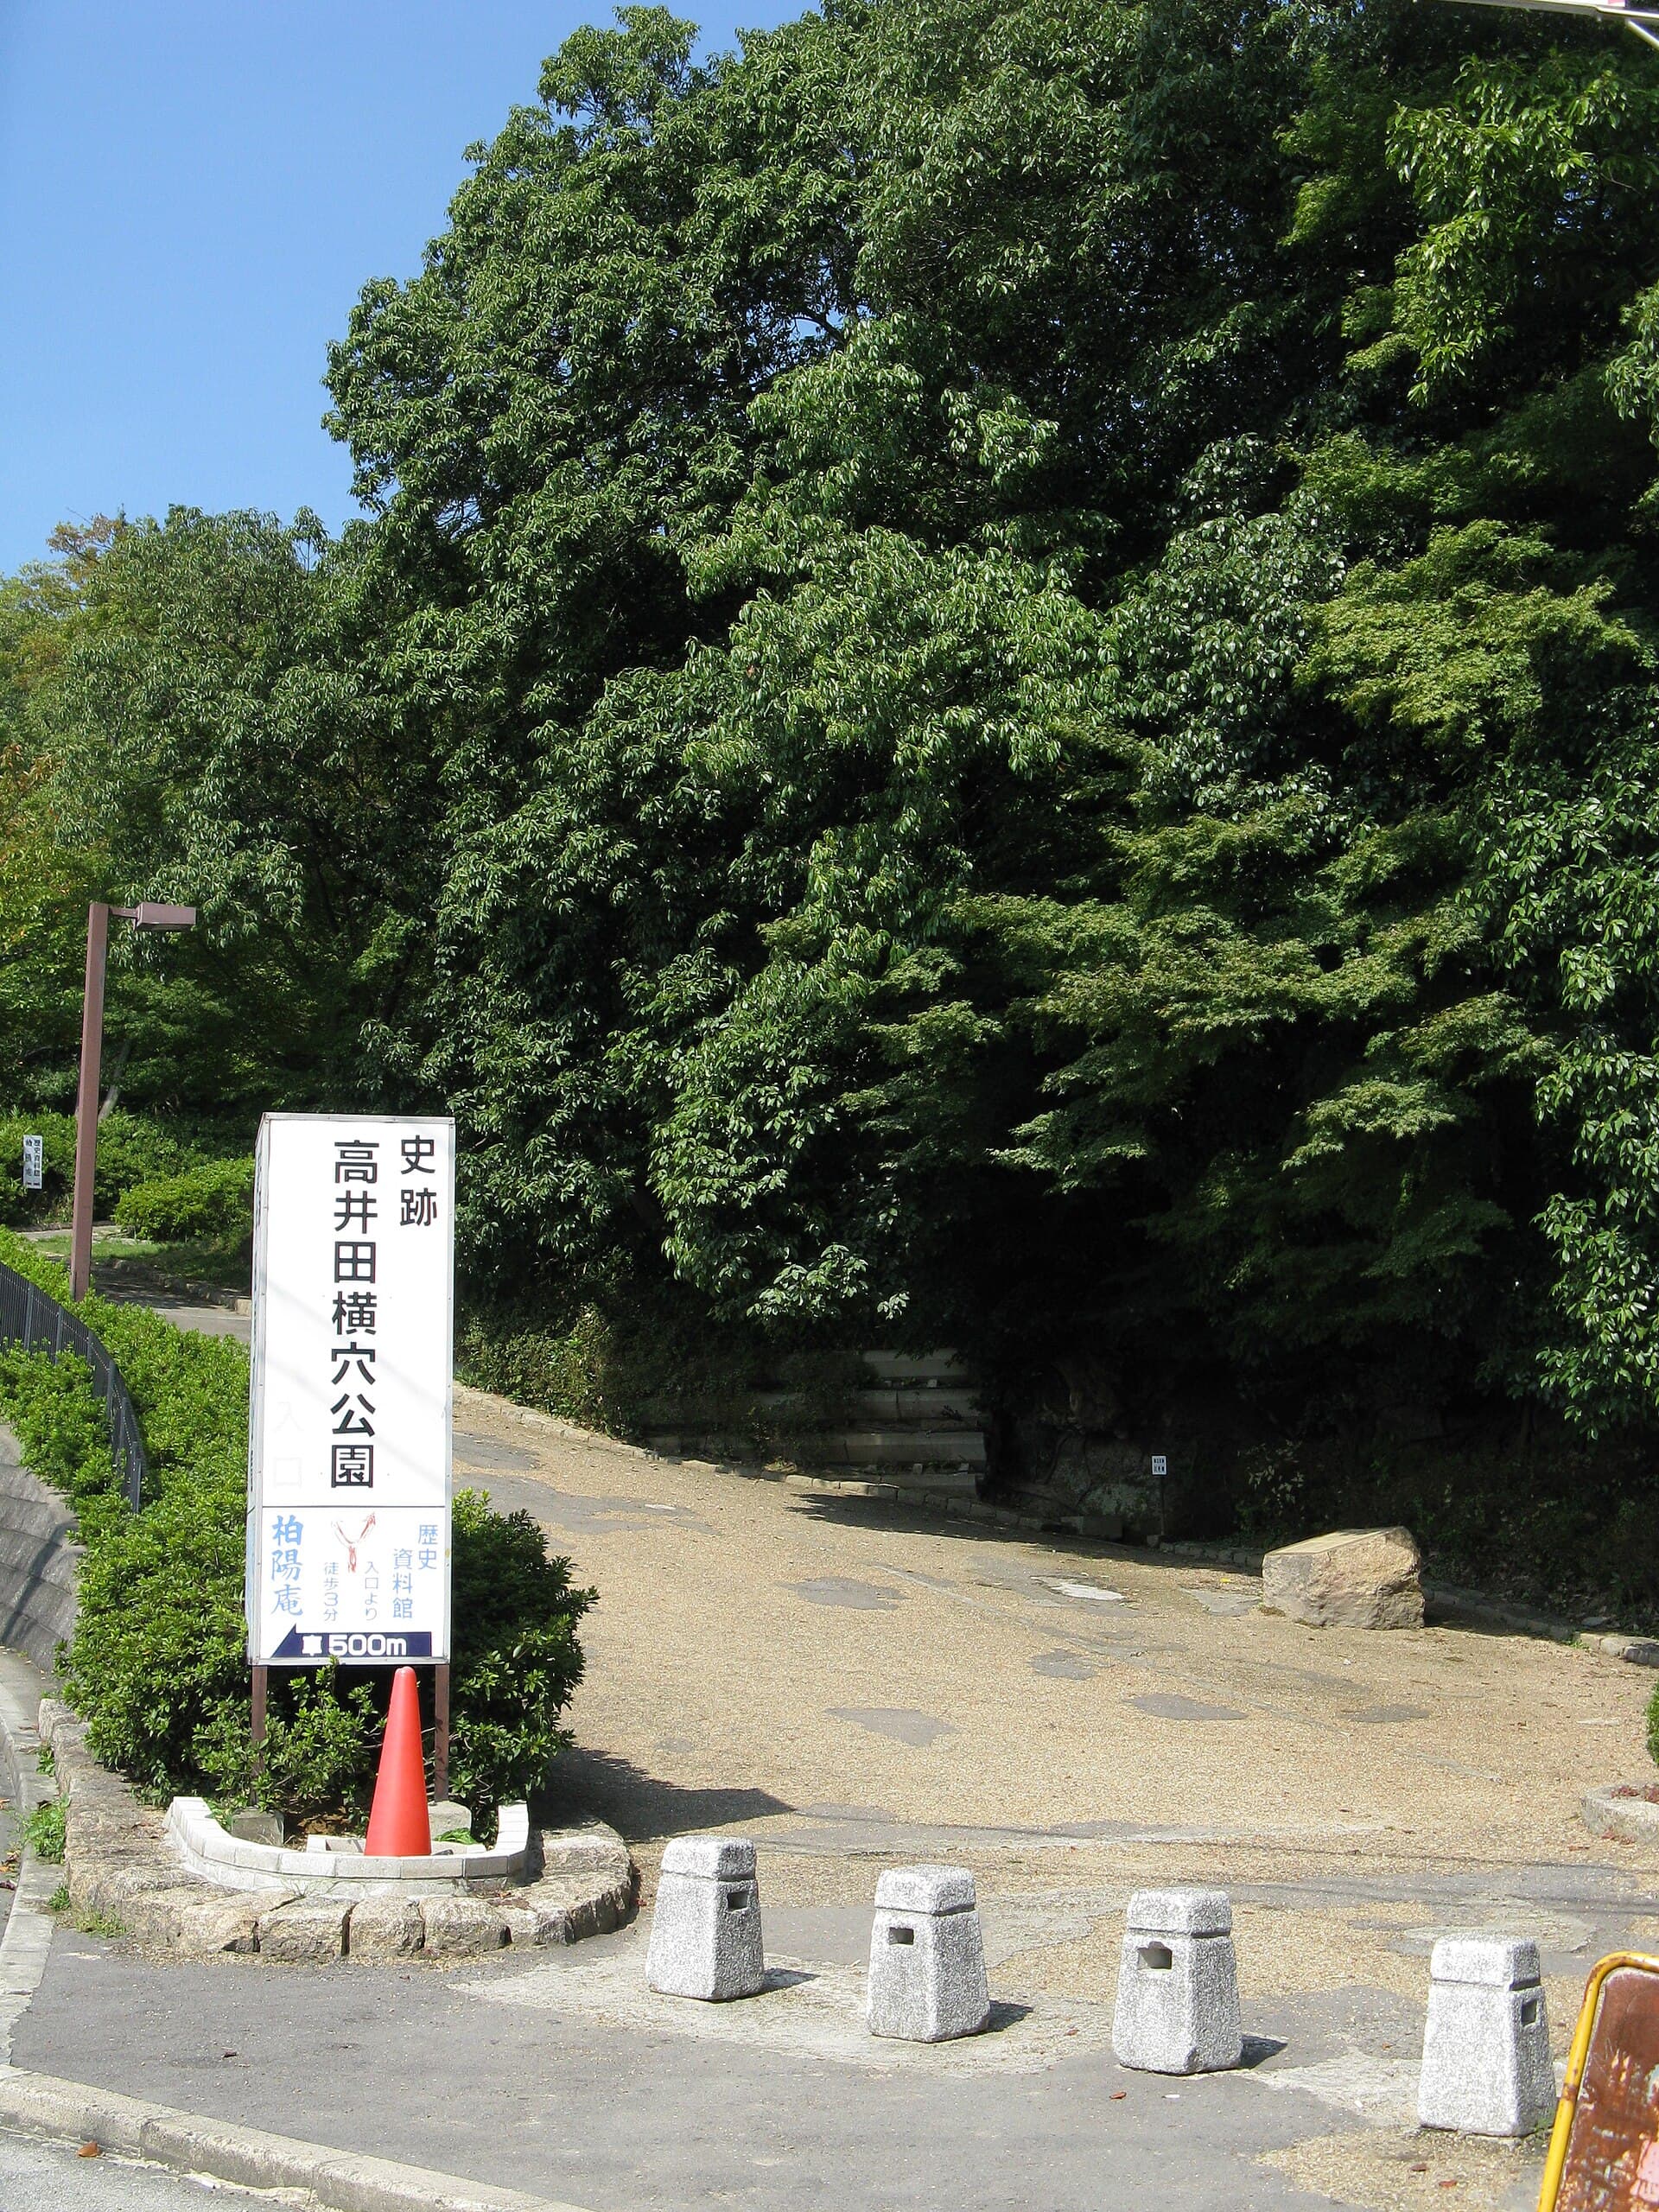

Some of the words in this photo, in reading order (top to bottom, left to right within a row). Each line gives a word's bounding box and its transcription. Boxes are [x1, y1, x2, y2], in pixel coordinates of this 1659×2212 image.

[400, 1135, 436, 1226] 史跡
[331, 1140, 379, 1488] 高井田横穴公園
[271, 1515, 303, 1616] 柏陽庵
[418, 1525, 437, 1569] 歴史
[365, 1561, 378, 1620] 入口より
[393, 1548, 412, 1618] 資料館
[328, 1634, 407, 1656] 500m
